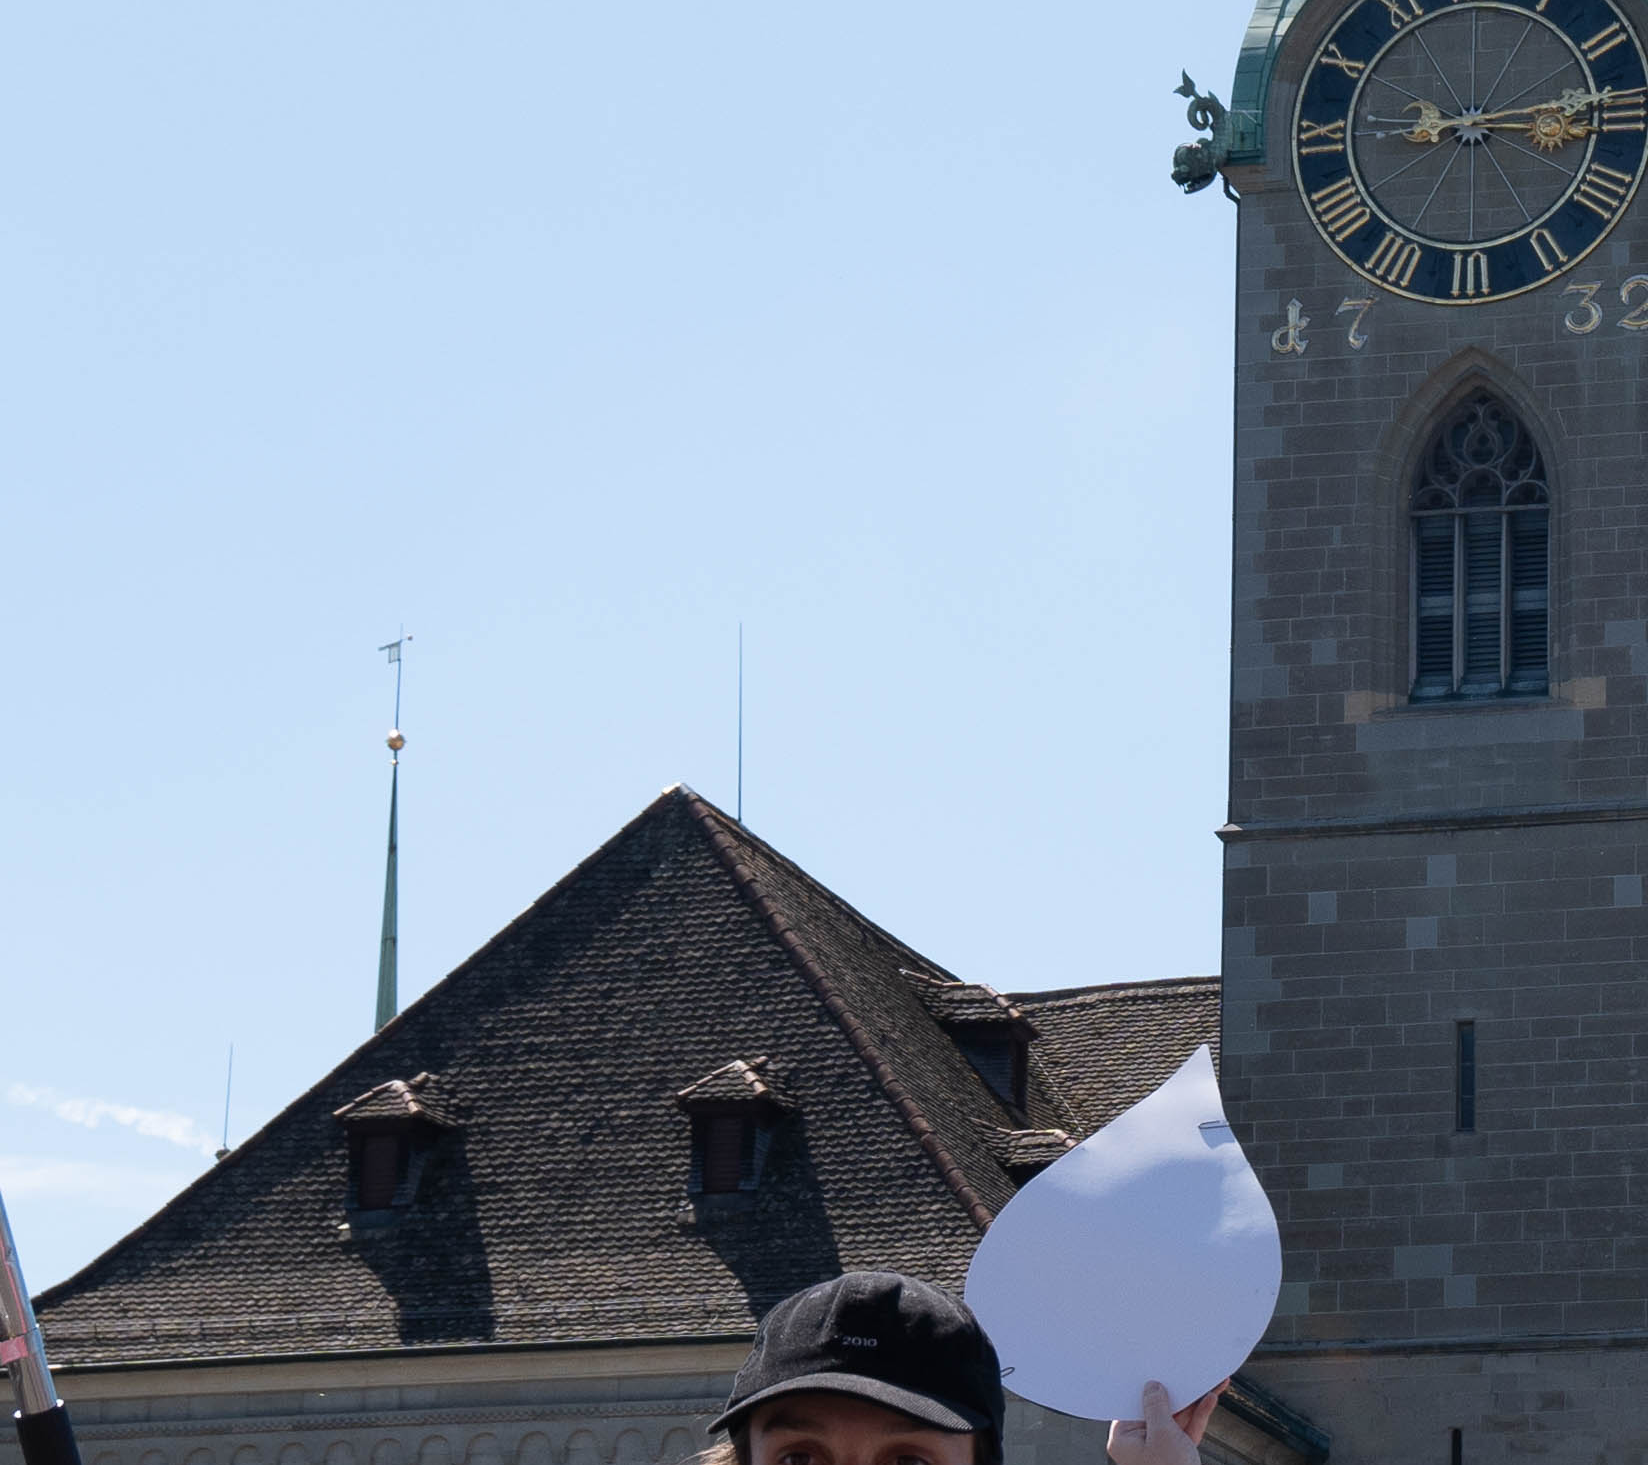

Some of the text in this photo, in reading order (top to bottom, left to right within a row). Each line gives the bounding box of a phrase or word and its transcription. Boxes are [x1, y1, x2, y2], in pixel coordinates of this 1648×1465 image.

[1580, 21, 1628, 61] II
[1319, 42, 1366, 79] X
[1601, 95, 1648, 132] III
[1300, 119, 1346, 156] IX
[1573, 162, 1632, 221] IIII
